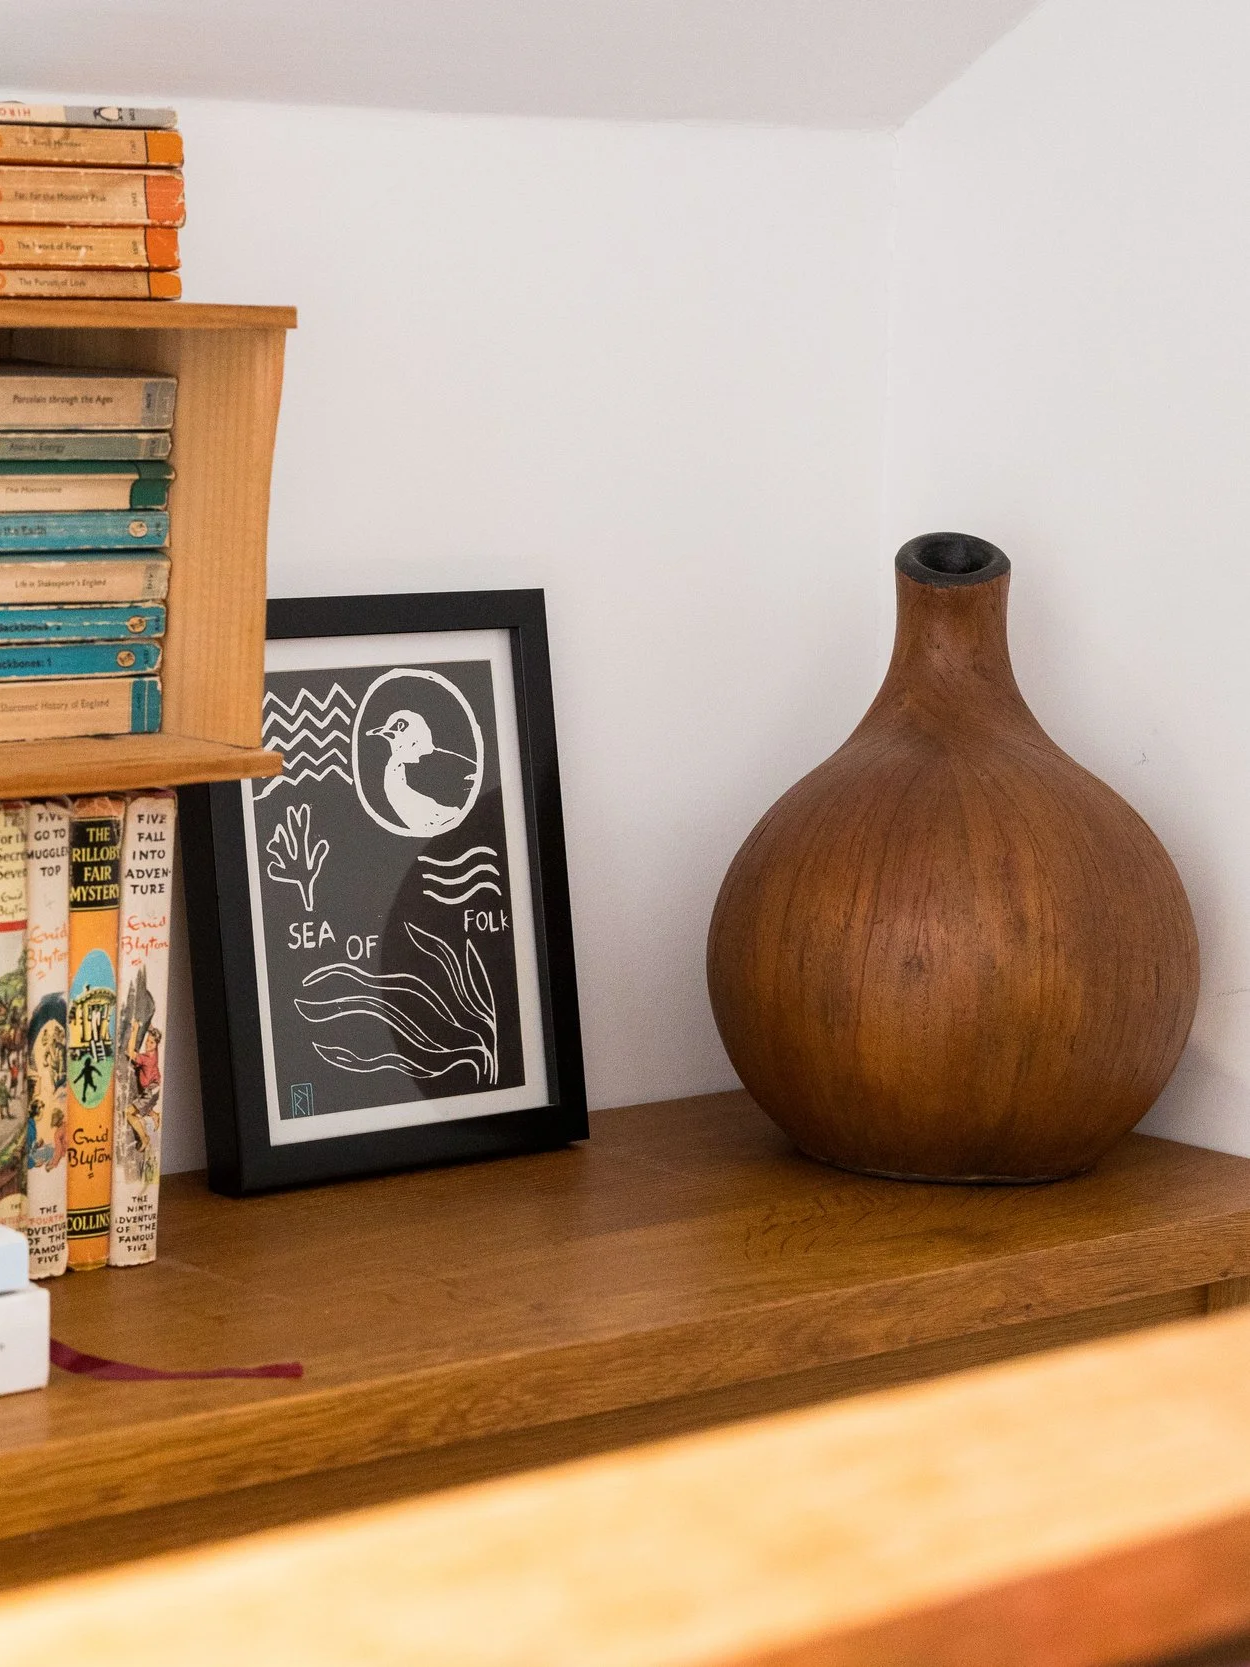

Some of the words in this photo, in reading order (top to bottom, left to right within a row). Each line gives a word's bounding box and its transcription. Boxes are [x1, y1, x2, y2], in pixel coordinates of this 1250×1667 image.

[81, 697, 110, 710] England
[137, 813, 167, 824] FIVE
[15, 830, 27, 844] th
[33, 830, 50, 842] GO
[53, 828, 66, 838] TO
[85, 827, 111, 842] THE
[137, 831, 166, 843] FALL
[72, 847, 120, 864] RILLOBY
[132, 849, 166, 861] INTO
[39, 866, 62, 877] TOP
[83, 866, 112, 882] FAIR
[125, 867, 171, 879] ADVEN-
[70, 884, 119, 903] MYSTERY
[130, 883, 165, 895] TURE
[127, 915, 167, 932] Enid
[288, 920, 336, 950] SEA
[346, 934, 379, 961] OF
[463, 908, 510, 933] FOLK
[121, 936, 169, 956] Blyton
[73, 1124, 110, 1145] Enid
[67, 1147, 113, 1175] Blyton
[132, 1195, 148, 1203] THE
[39, 1205, 58, 1215] THE
[126, 1203, 154, 1214] NINTH
[66, 1212, 110, 1232] COLLINS
[116, 1225, 130, 1235] OF
[138, 1222, 156, 1232] THE
[28, 1237, 41, 1247] OF
[48, 1232, 67, 1243] THE
[118, 1232, 155, 1244] FAMOUS
[29, 1242, 66, 1257] FAMOUS
[126, 1243, 148, 1253] FIVE
[37, 1253, 60, 1265] FIVE
